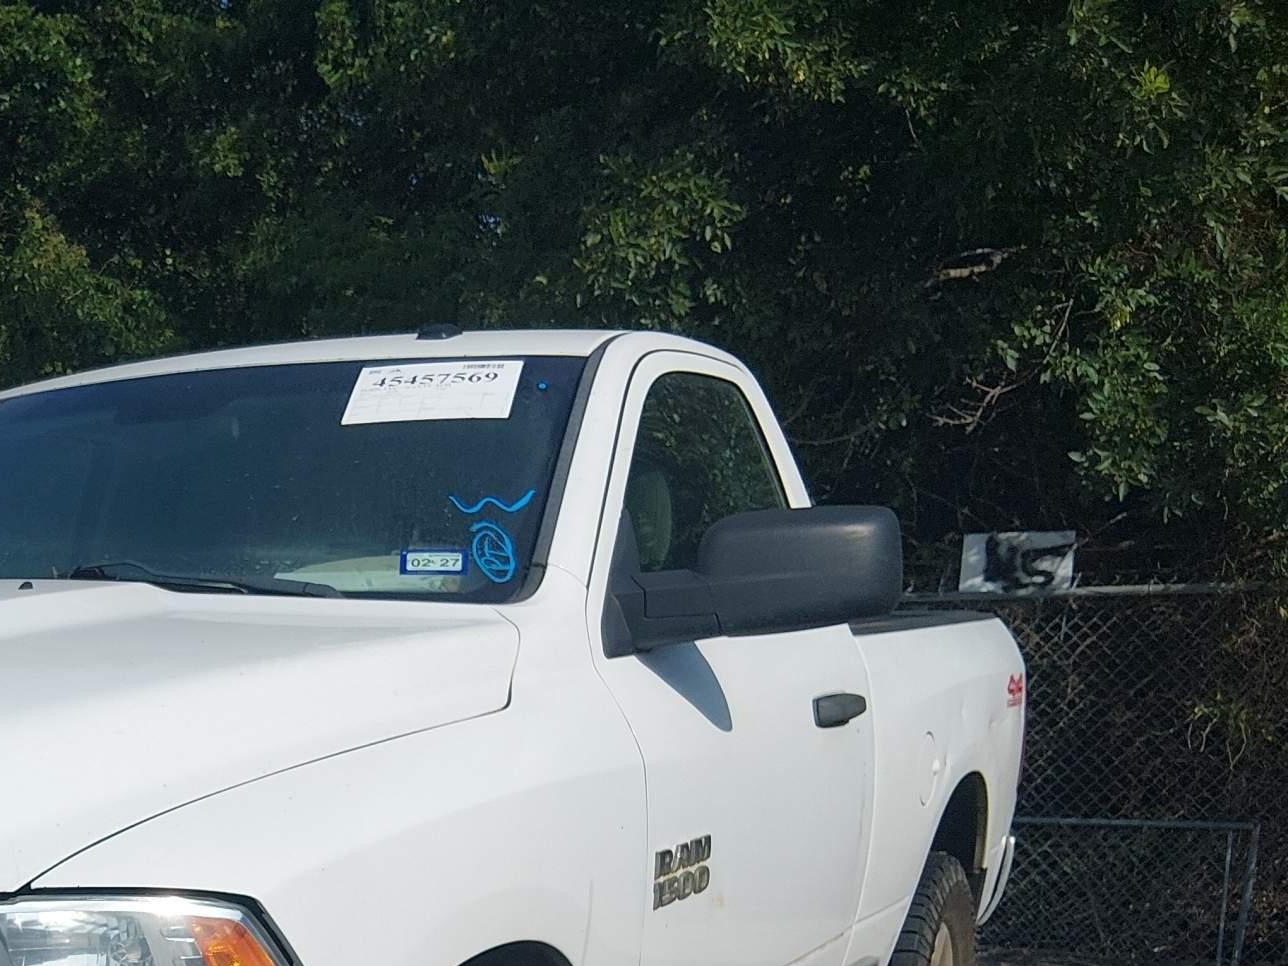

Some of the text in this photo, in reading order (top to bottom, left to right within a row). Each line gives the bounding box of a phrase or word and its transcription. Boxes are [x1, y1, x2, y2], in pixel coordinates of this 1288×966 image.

[372, 371, 499, 388] 45457569
[410, 558, 460, 568] 02 27
[654, 834, 712, 881] RAM
[652, 865, 710, 912] 1500
